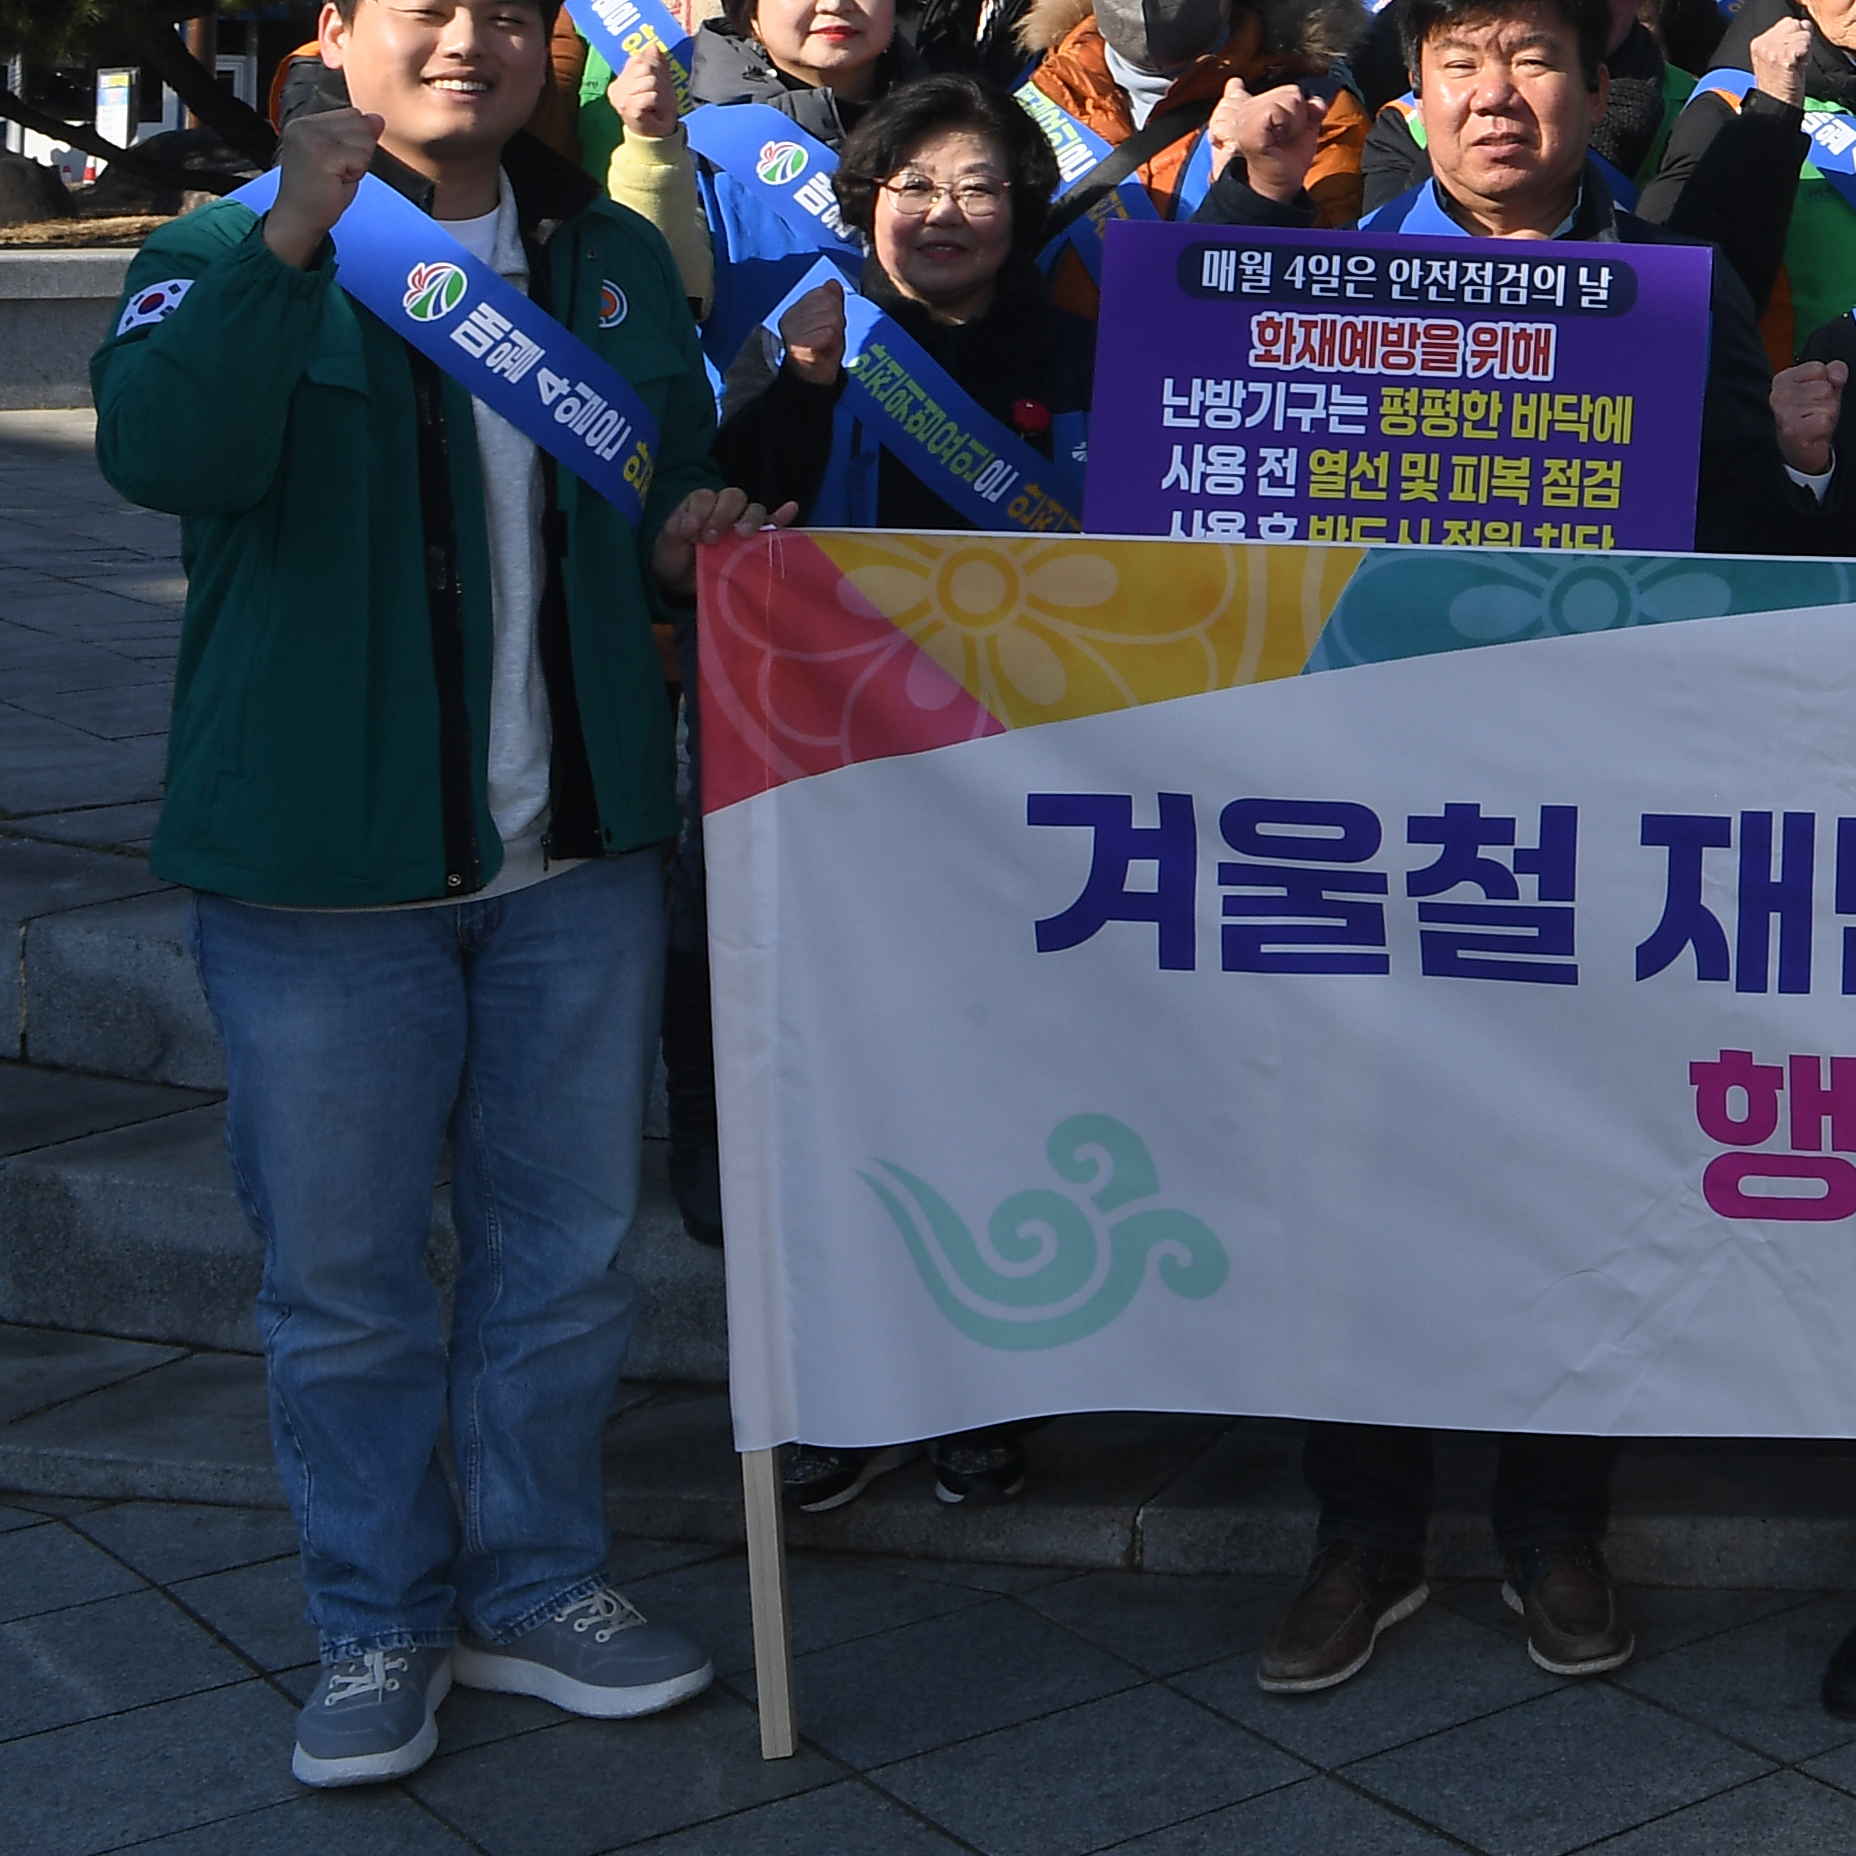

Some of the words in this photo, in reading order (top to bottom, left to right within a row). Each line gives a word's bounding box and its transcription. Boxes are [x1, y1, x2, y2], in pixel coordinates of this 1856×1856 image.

[1202, 249, 1273, 295] 매월
[1283, 254, 1377, 299] 4일은
[1391, 258, 1564, 307] 안전점검의
[1578, 265, 1613, 310] 날
[1251, 313, 1462, 375] 화재예방을
[1469, 323, 1554, 379] 위해
[451, 303, 544, 382] 매월
[535, 365, 630, 462] 4일은
[1162, 378, 1369, 434] 난방기구는
[1379, 386, 1502, 439] 평평한
[1511, 392, 1633, 445] 바닥에
[1162, 445, 1246, 495] 사용
[1257, 448, 1297, 498] 전
[1308, 448, 1390, 501] 열선
[1399, 452, 1439, 503] 및
[1450, 454, 1530, 507] 피복
[1541, 459, 1622, 510] 점검
[1024, 793, 1582, 988] 겨울철
